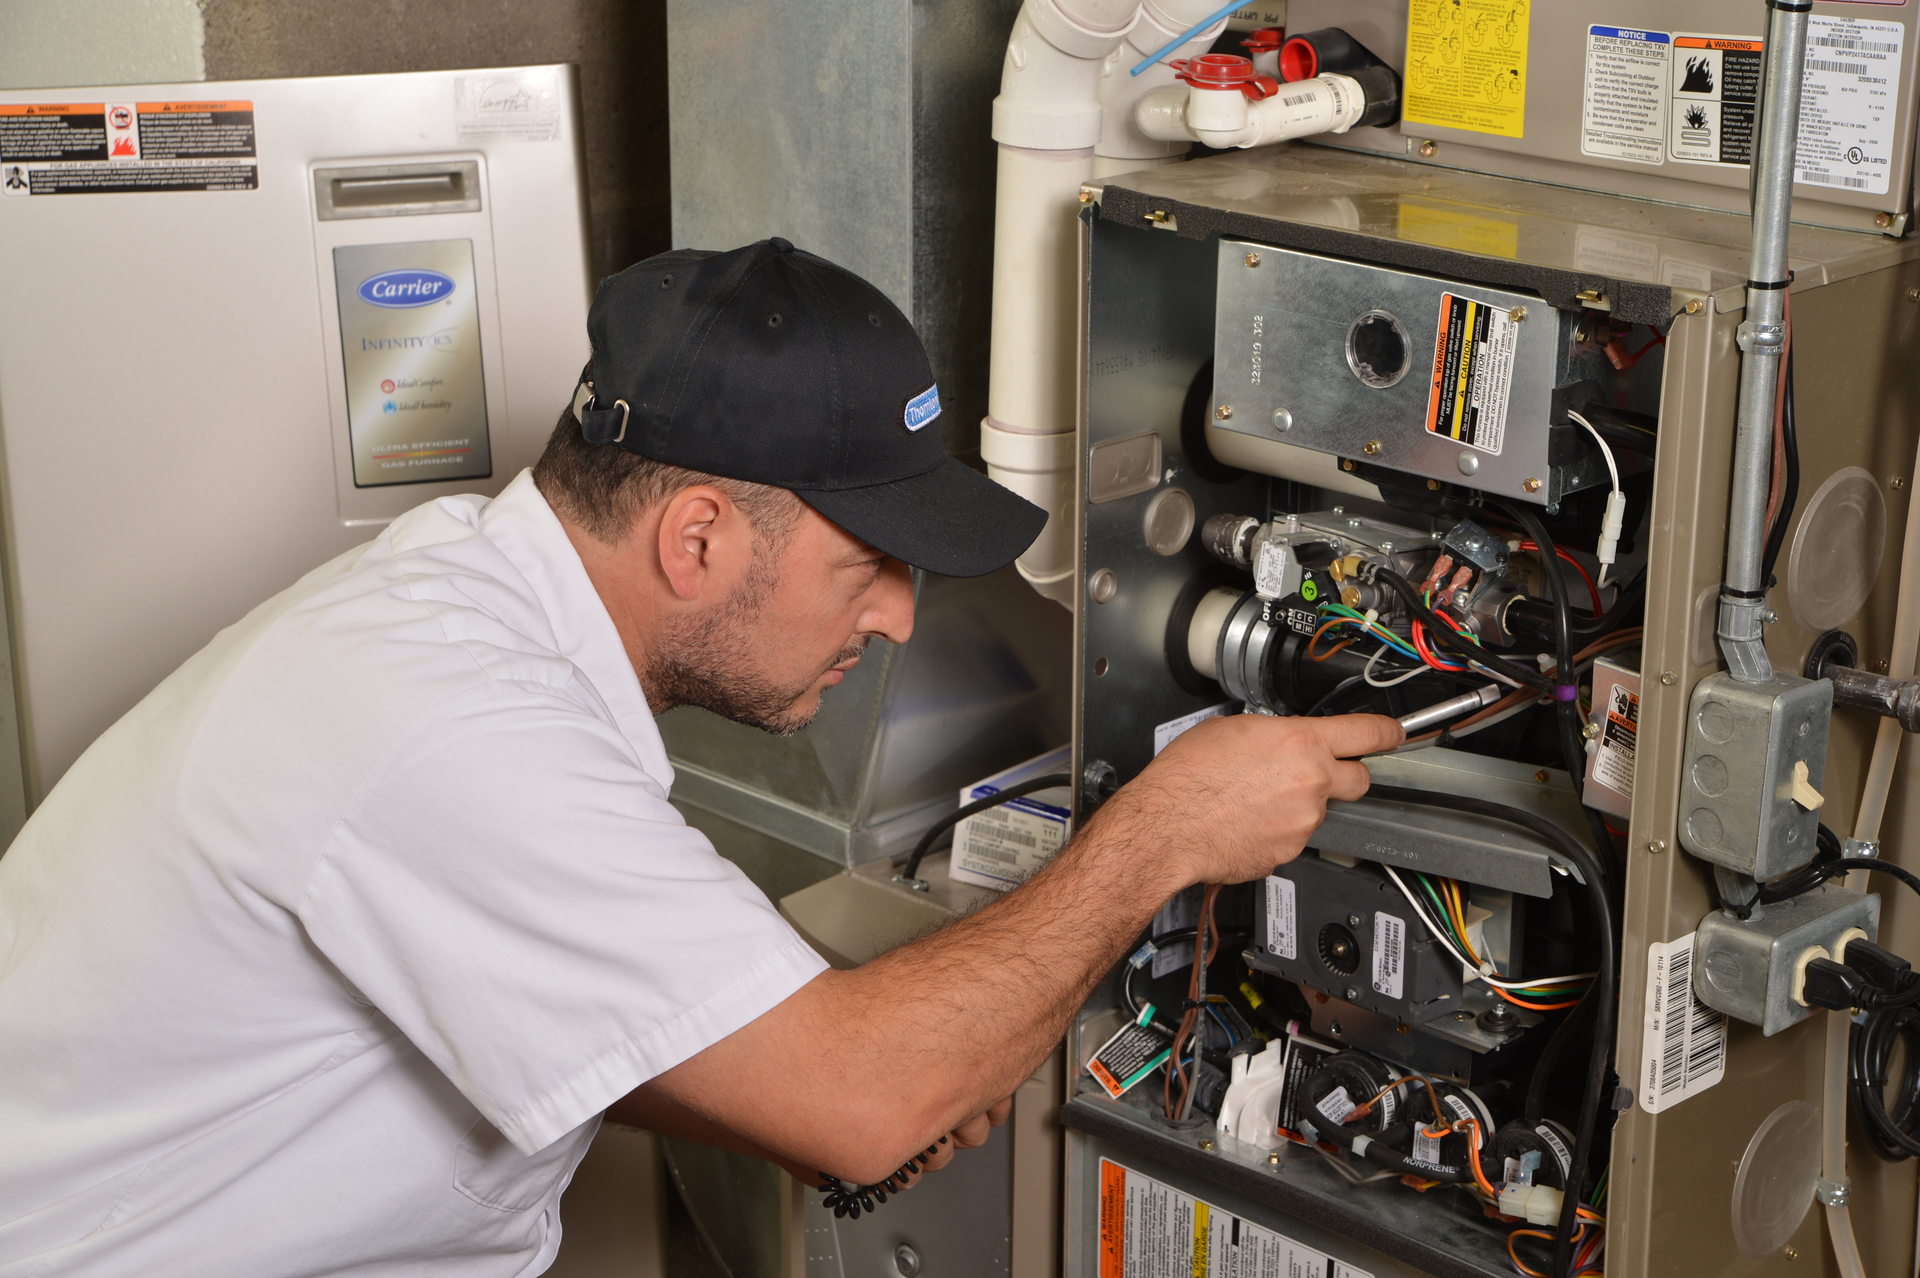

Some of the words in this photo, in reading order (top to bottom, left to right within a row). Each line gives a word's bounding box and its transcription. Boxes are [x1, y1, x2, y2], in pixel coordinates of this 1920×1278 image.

[1594, 36, 1617, 45] BEFORE
[1619, 39, 1652, 48] REPLACING
[1618, 30, 1646, 40] NOTICE
[1592, 43, 1623, 53] COMPLETE
[1625, 47, 1644, 55] THESE
[1645, 49, 1666, 58] STEPS:
[1714, 40, 1752, 50] WARNING
[372, 279, 442, 298] Carrier
[361, 336, 425, 351] INFINITY
[1436, 332, 1446, 374] WARNING
[1461, 340, 1470, 379] CAUTION
[1474, 353, 1485, 402] OPERATION
[1462, 423, 1467, 431] Do
[372, 443, 409, 452] ULTRA
[411, 439, 470, 448] EFFICIENT
[381, 460, 406, 469] GAS
[409, 456, 464, 466] FURNACE
[1304, 571, 1312, 580] HI
[1305, 586, 1315, 596] 3
[1262, 600, 1271, 621] OFF
[1287, 608, 1294, 625] ON
[1609, 742, 1634, 761] INSTALLA
[1647, 1093, 1655, 1105] S/N:
[1652, 1017, 1660, 1031] M/N:
[1403, 1156, 1456, 1174] NORPRENE
[1200, 1252, 1207, 1263] EN
